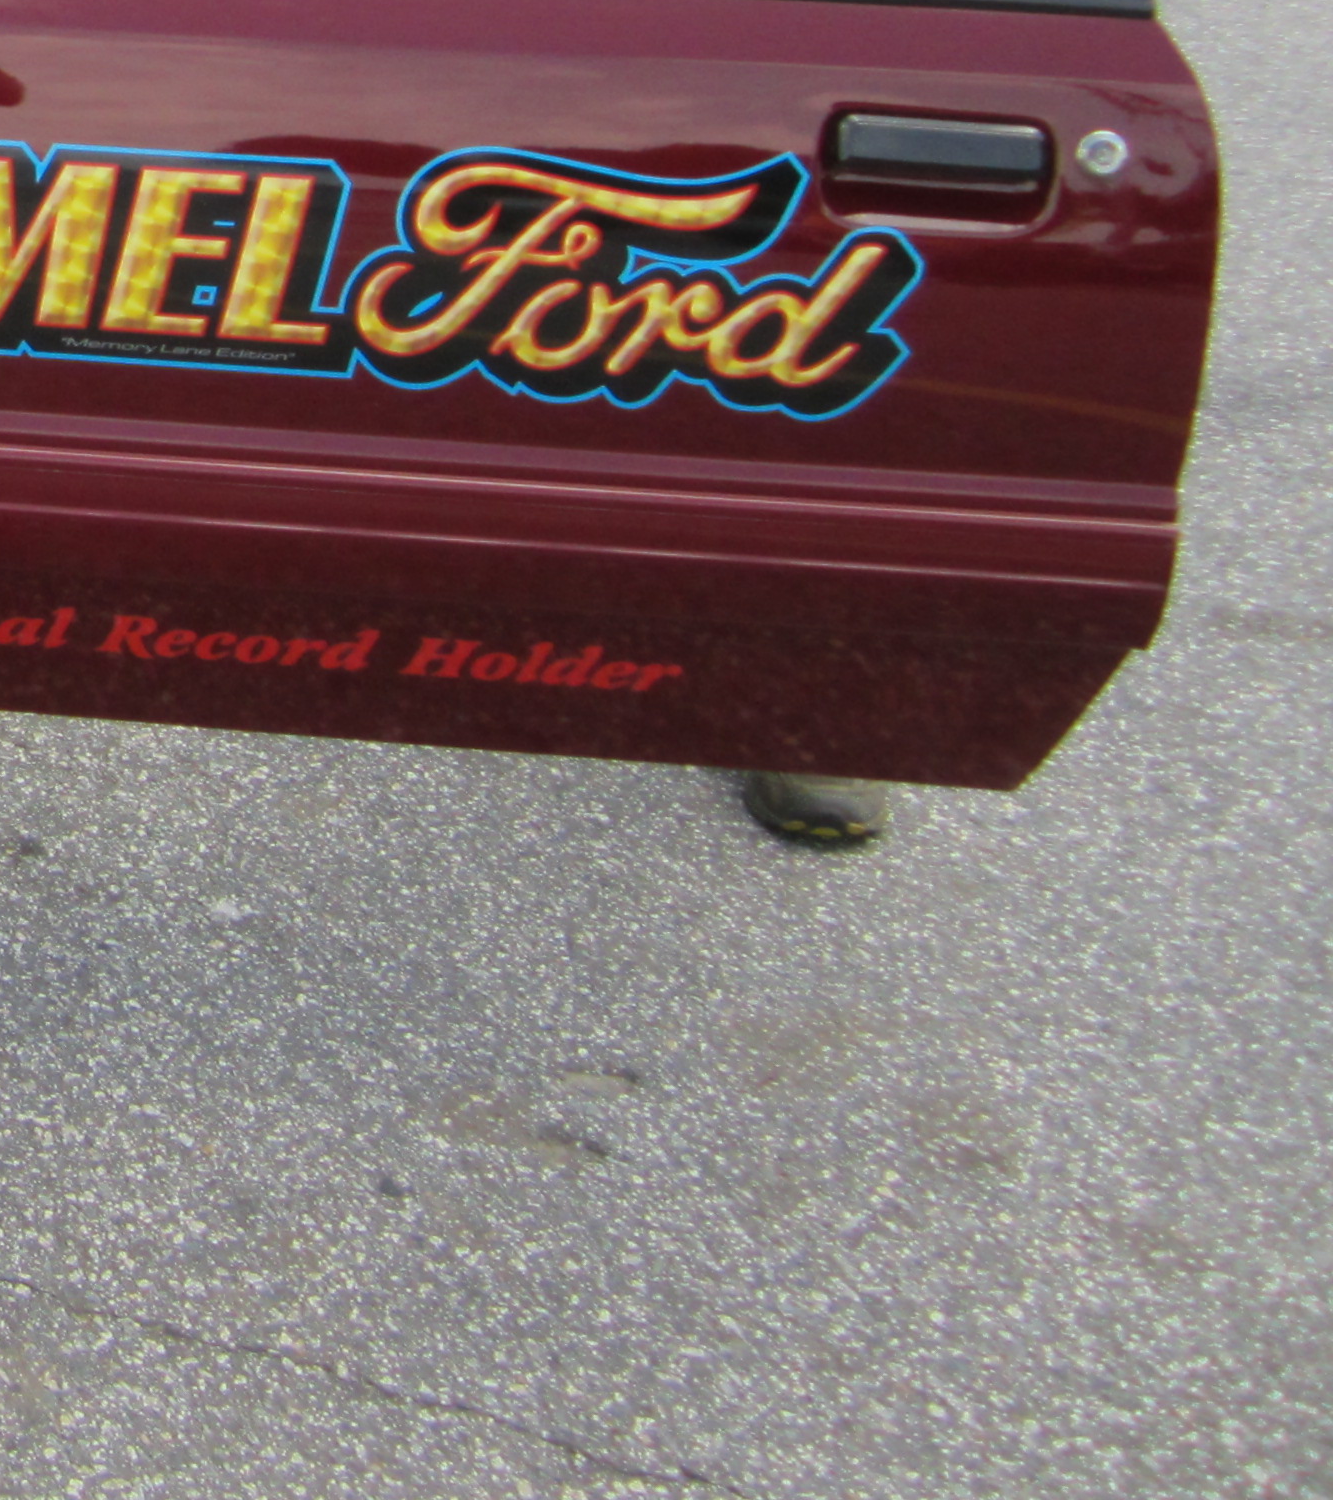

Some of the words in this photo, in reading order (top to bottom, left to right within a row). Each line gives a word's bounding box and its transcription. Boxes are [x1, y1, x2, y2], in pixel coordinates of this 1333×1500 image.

[355, 162, 888, 388] Ford
[161, 344, 212, 357] Lane
[96, 613, 381, 672] Record
[399, 635, 684, 692] Holder
